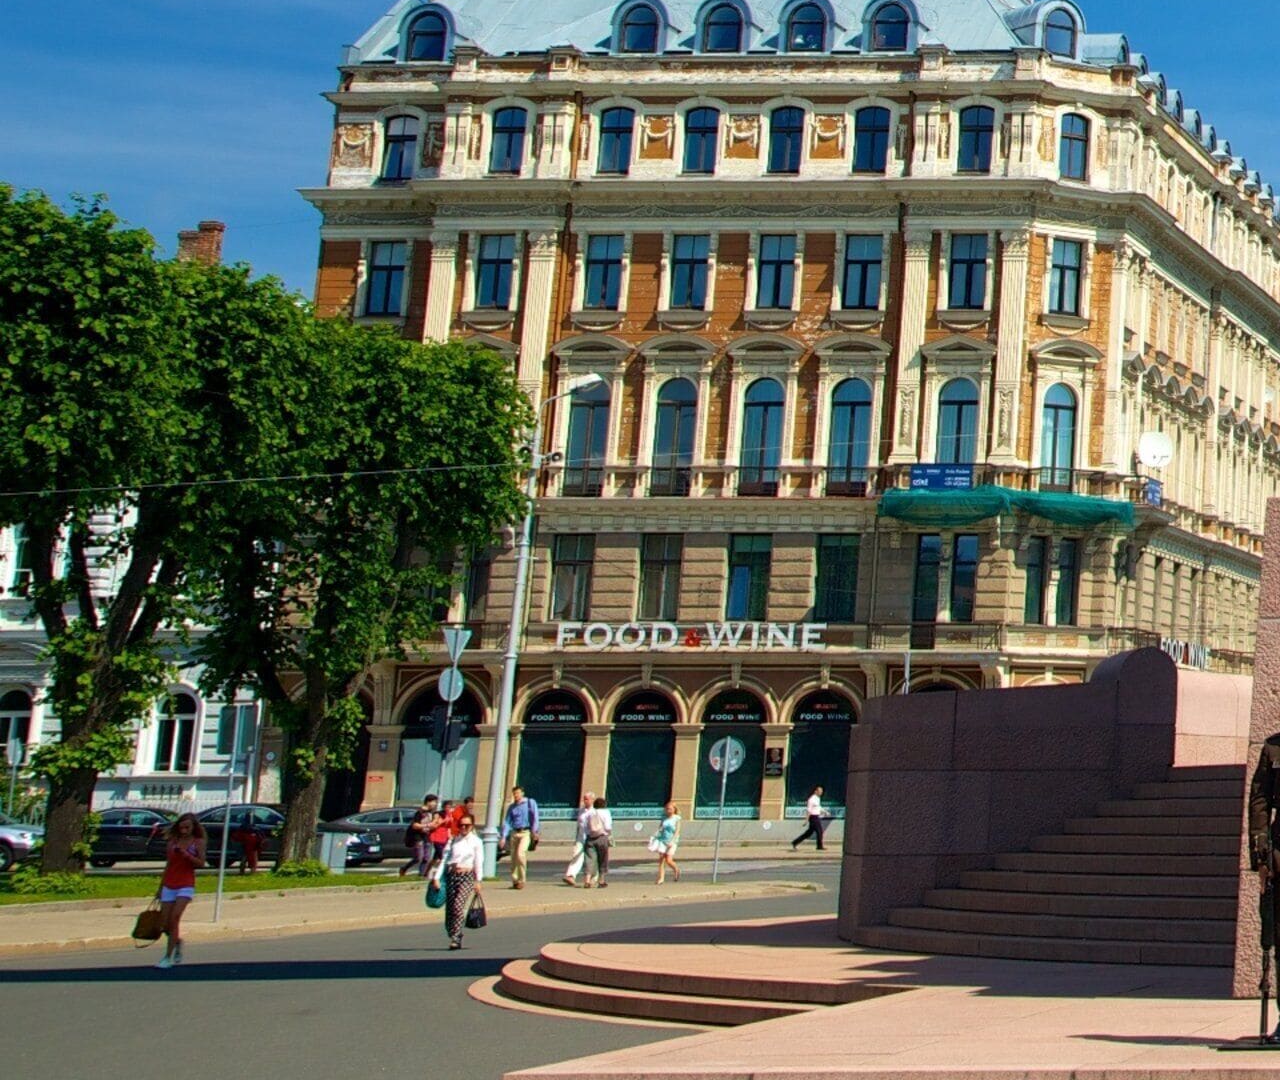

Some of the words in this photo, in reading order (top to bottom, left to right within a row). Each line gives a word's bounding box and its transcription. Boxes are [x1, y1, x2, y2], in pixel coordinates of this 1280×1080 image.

[556, 622, 678, 651] FOOD
[685, 628, 701, 648] &
[706, 622, 828, 651] WINE
